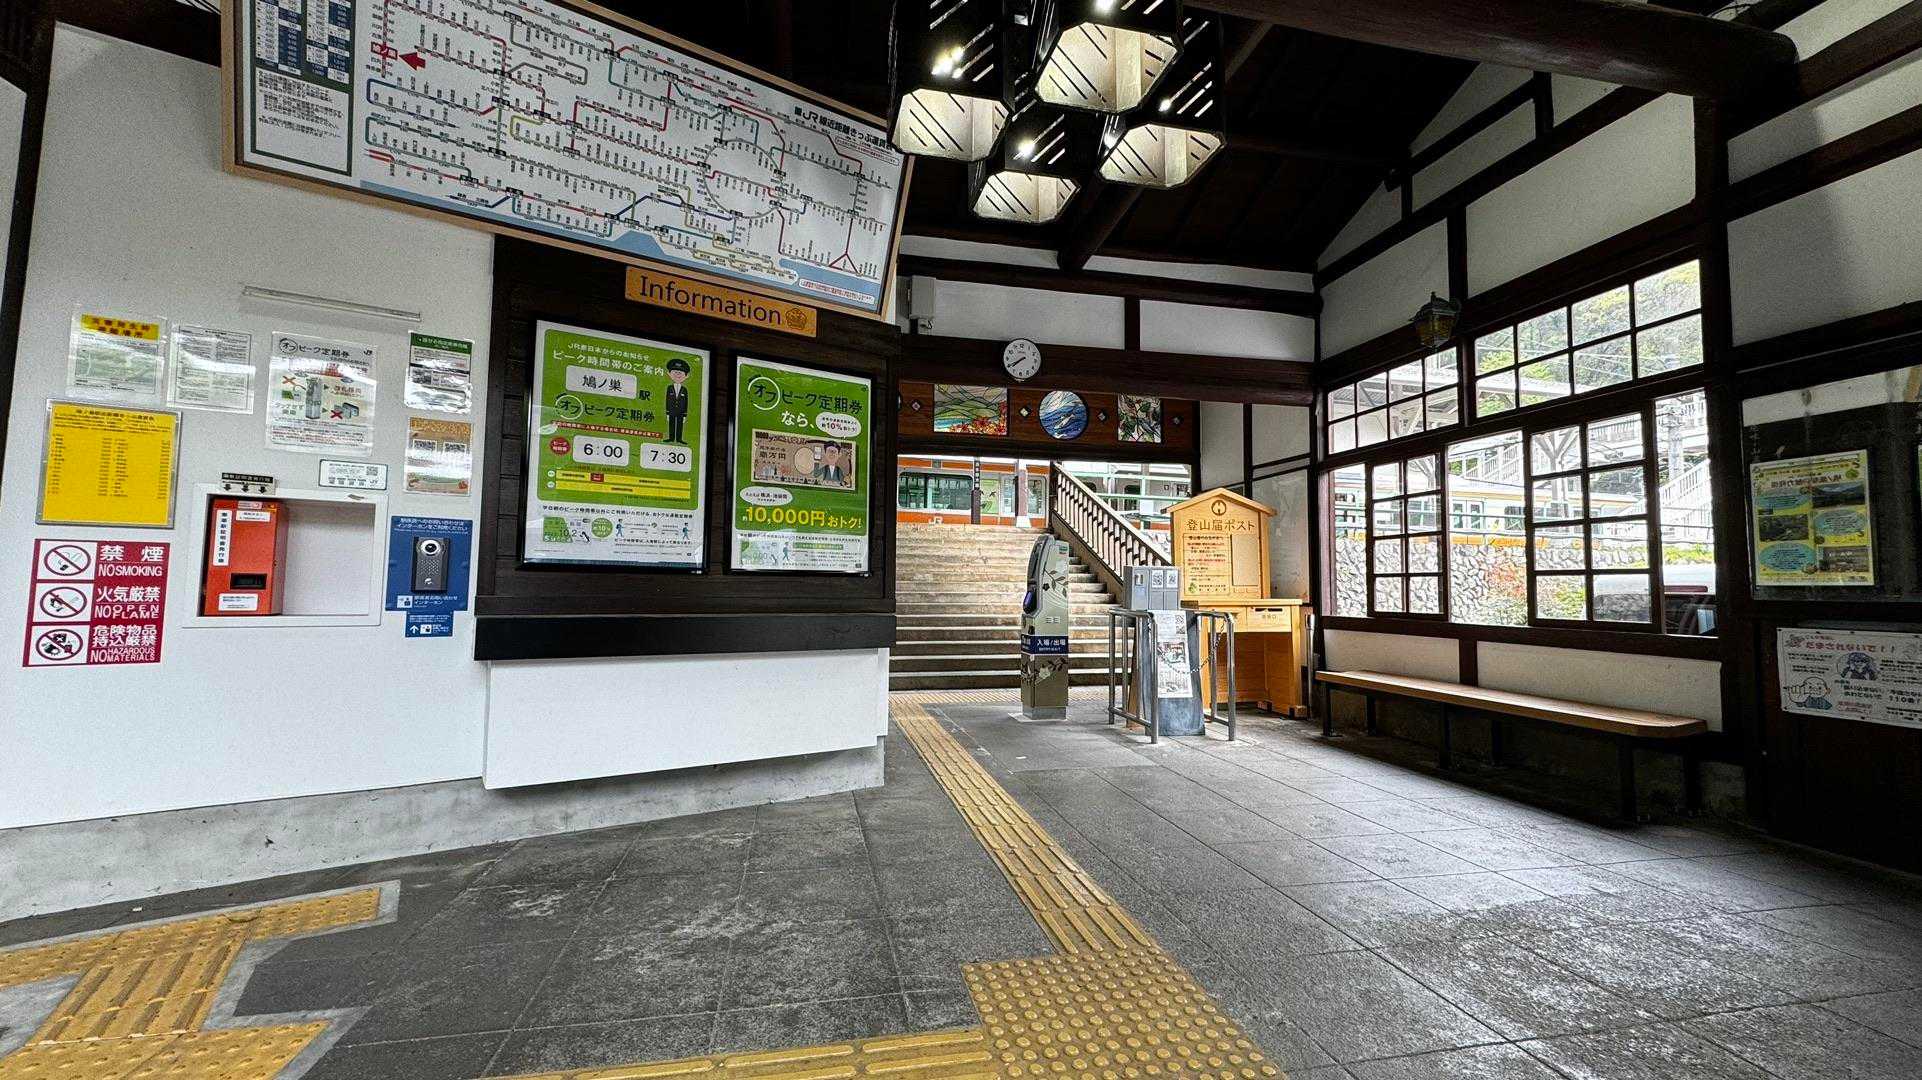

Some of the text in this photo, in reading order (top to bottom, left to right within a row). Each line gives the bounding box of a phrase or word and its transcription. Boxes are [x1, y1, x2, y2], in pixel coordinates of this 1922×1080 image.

[639, 275, 781, 325] Information
[568, 343, 650, 361] JR東日本からのお知らせ
[552, 350, 664, 377] ピーク時間帯のご案内
[582, 374, 651, 401] 鳩ノ巣 駅
[753, 384, 862, 414] オフピーク定期券
[559, 399, 655, 422] オフピーク定期券
[782, 411, 815, 429] なら、
[584, 443, 623, 458] 6:00
[650, 450, 686, 464] 7:30
[928, 516, 942, 525] JR
[1186, 518, 1255, 532] 登山届ポスト
[100, 545, 164, 562] 禁煙
[98, 563, 162, 577] NO SMOKING
[96, 586, 160, 603] 火気厳禁
[95, 605, 111, 619] NO
[112, 604, 159, 612] OPEN
[112, 611, 159, 619] FLAME
[93, 625, 157, 637] 危険物品
[93, 636, 155, 647] 持込厳禁
[90, 649, 107, 663] NO
[107, 647, 155, 655] HAZARDOUS
[107, 654, 155, 662] MATERIALS
